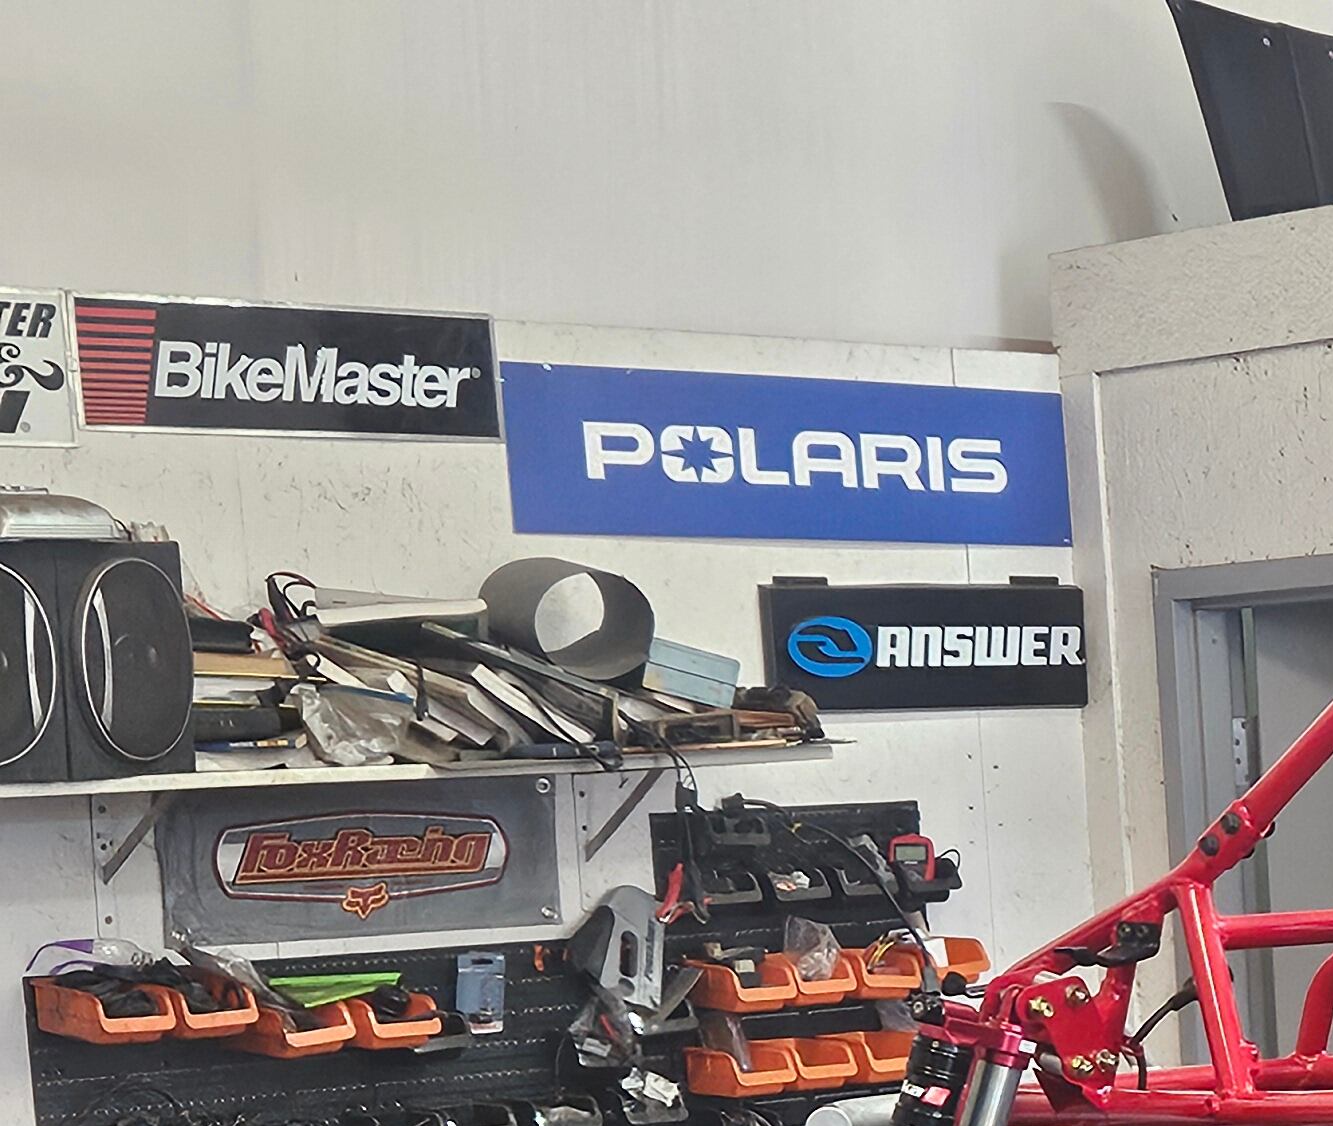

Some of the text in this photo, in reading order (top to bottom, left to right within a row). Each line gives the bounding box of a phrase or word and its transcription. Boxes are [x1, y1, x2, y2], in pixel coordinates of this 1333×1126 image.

[154, 340, 471, 408] BikeMaster
[581, 420, 1009, 494] POLARIS
[875, 625, 1082, 668] ANSWER
